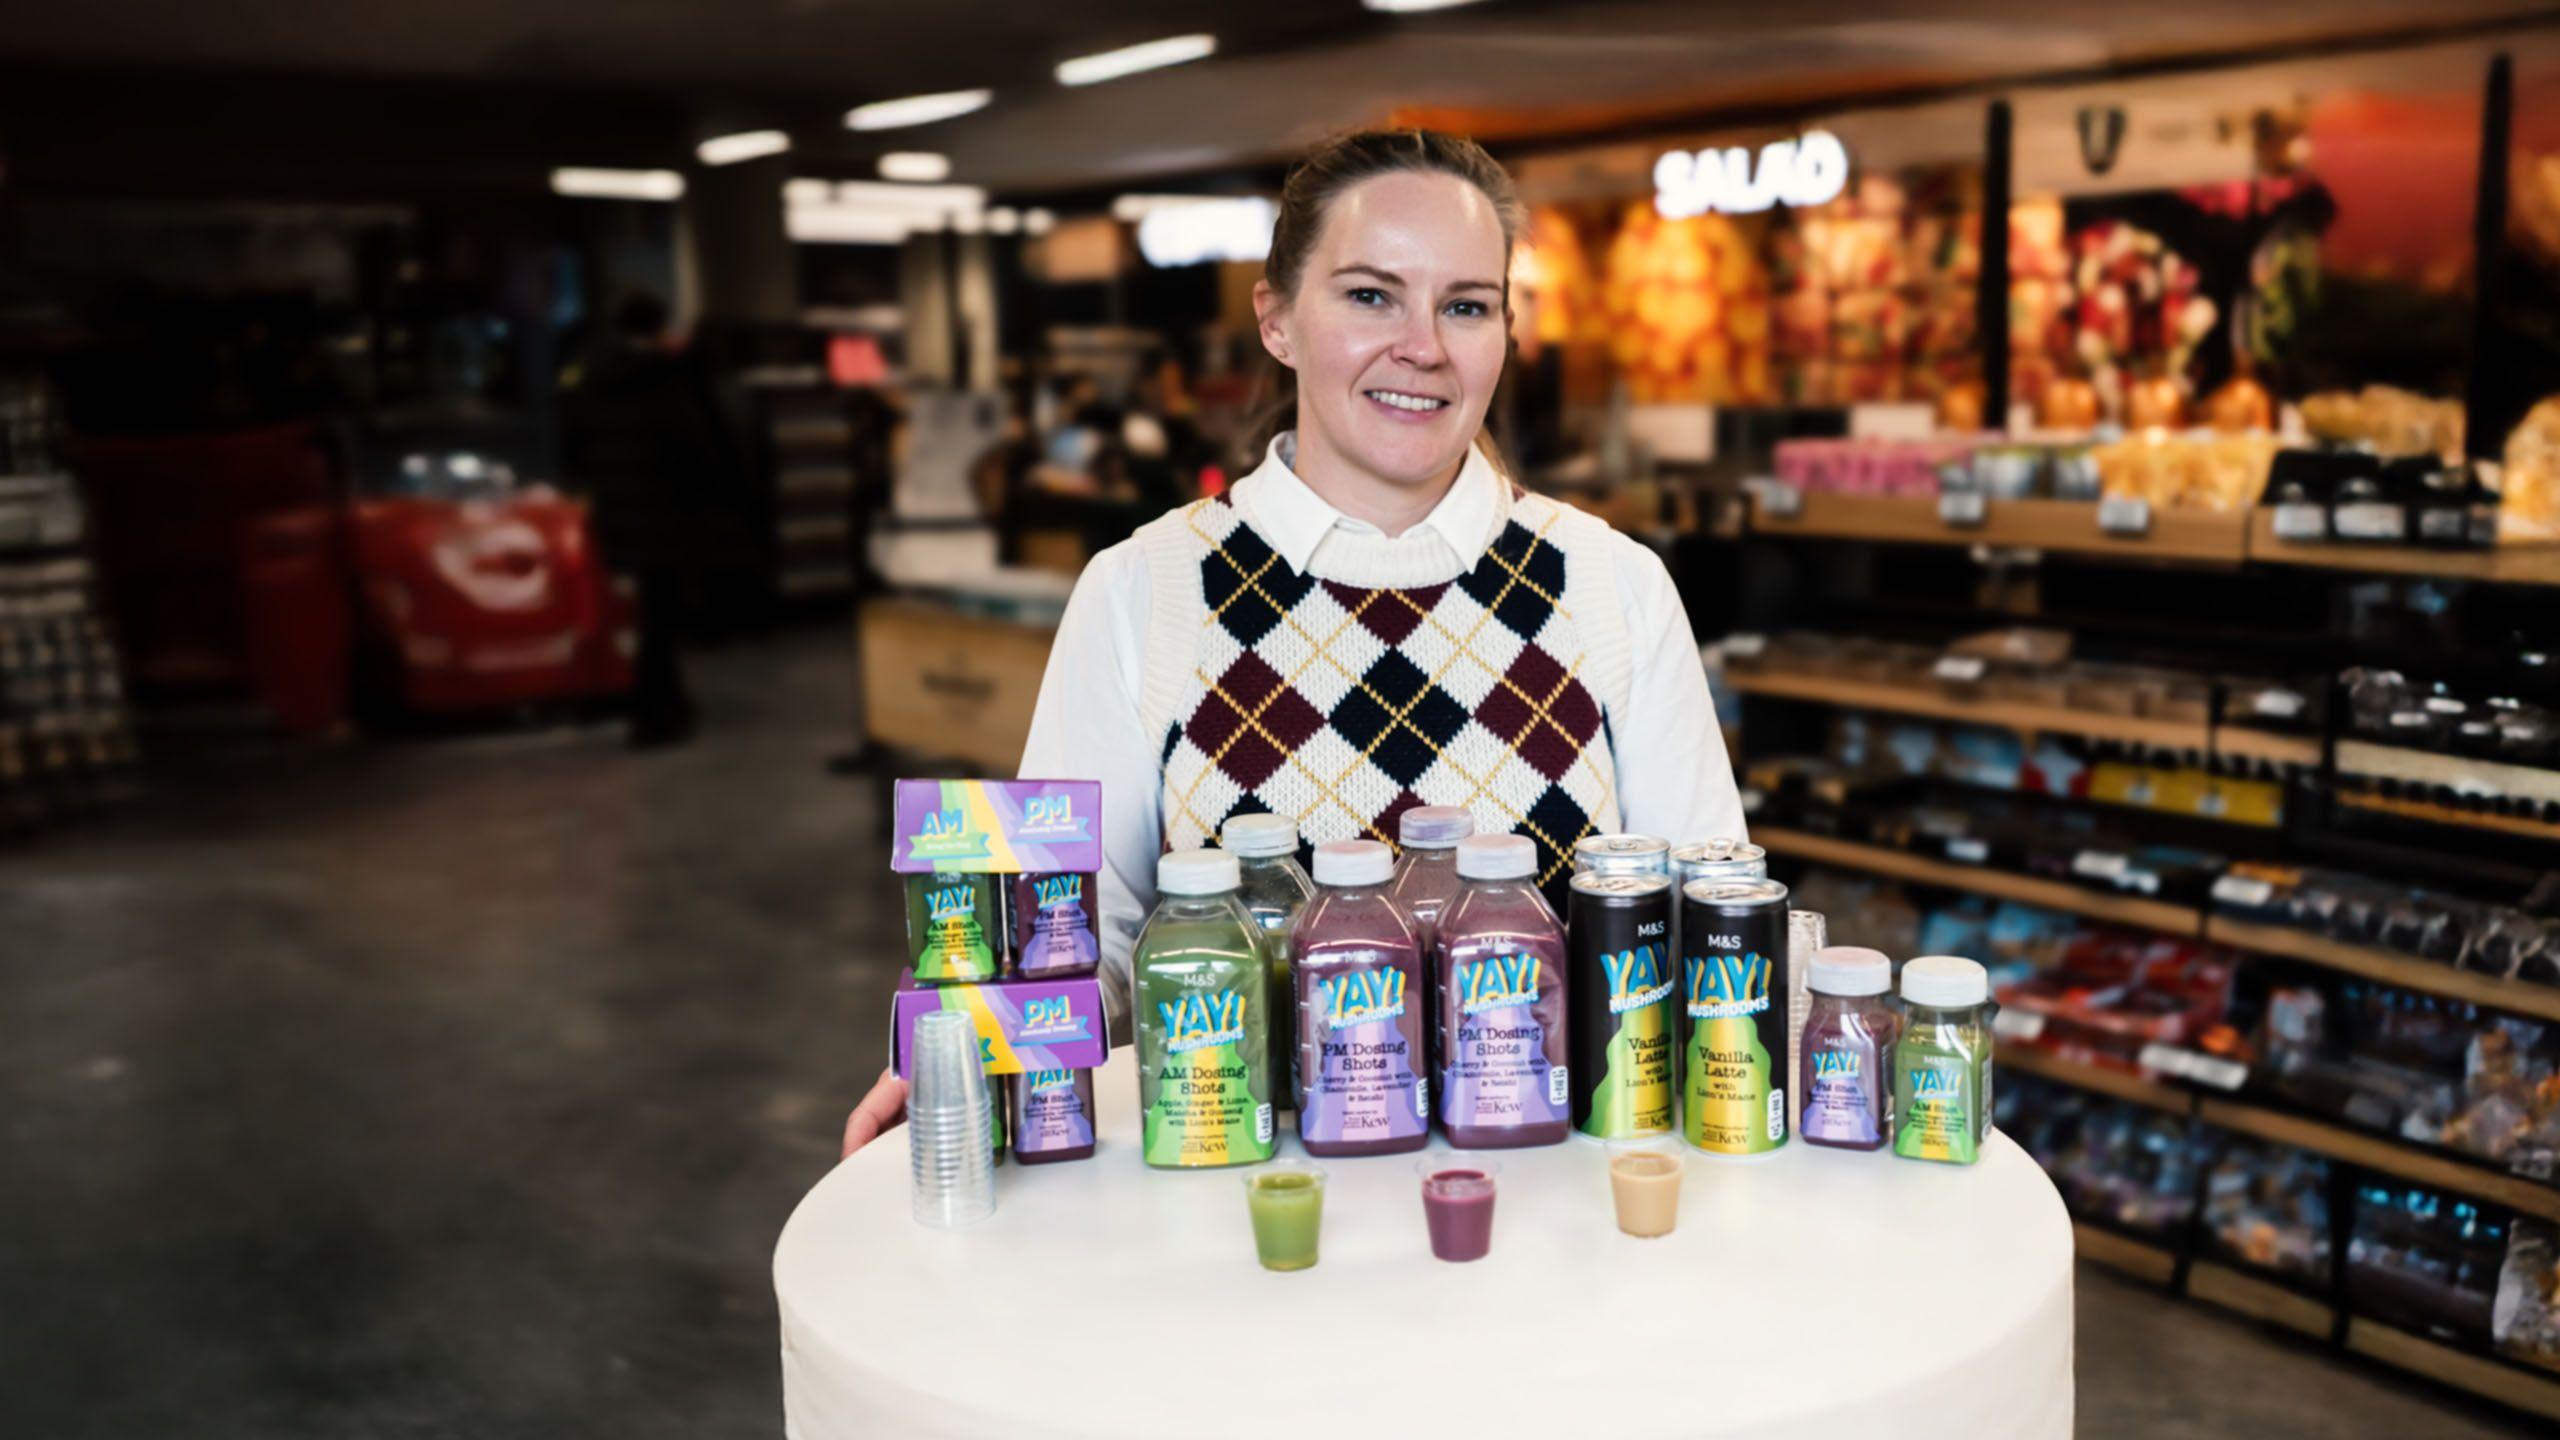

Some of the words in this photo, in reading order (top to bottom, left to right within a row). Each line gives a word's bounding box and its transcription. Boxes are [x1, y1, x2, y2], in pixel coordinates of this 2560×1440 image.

[1654, 131, 1848, 219] SALAD
[1024, 794, 1072, 826] PM
[921, 808, 968, 841] AM
[1033, 873, 1082, 905] YAY!
[924, 885, 976, 917] YAY!
[1638, 921, 1664, 937] M&S
[1708, 934, 1741, 949] M&S
[1183, 973, 1217, 986] M&S
[1455, 952, 1542, 1003] YAY!
[1685, 952, 1773, 1004] YAY!
[1319, 965, 1407, 1022] YAY!
[1024, 996, 1071, 1028] PM
[1157, 986, 1247, 1040] YAY!
[1687, 997, 1769, 1017] MUSHROOMS
[1458, 1028, 1482, 1041] PM
[1486, 1027, 1541, 1042] Dosing
[1323, 1044, 1347, 1056] PM
[1353, 1041, 1406, 1056] Dosing
[1476, 1043, 1521, 1056] Shots
[1698, 1047, 1754, 1063] Vanilla
[1159, 1067, 1186, 1080] AM
[1193, 1065, 1246, 1080] Dosing
[1342, 1058, 1387, 1071] Shots
[1704, 1064, 1746, 1077] Latte
[1812, 1051, 1860, 1075] YAY!
[1180, 1082, 1226, 1095] Shots
[1911, 1070, 1961, 1095] YAY!
